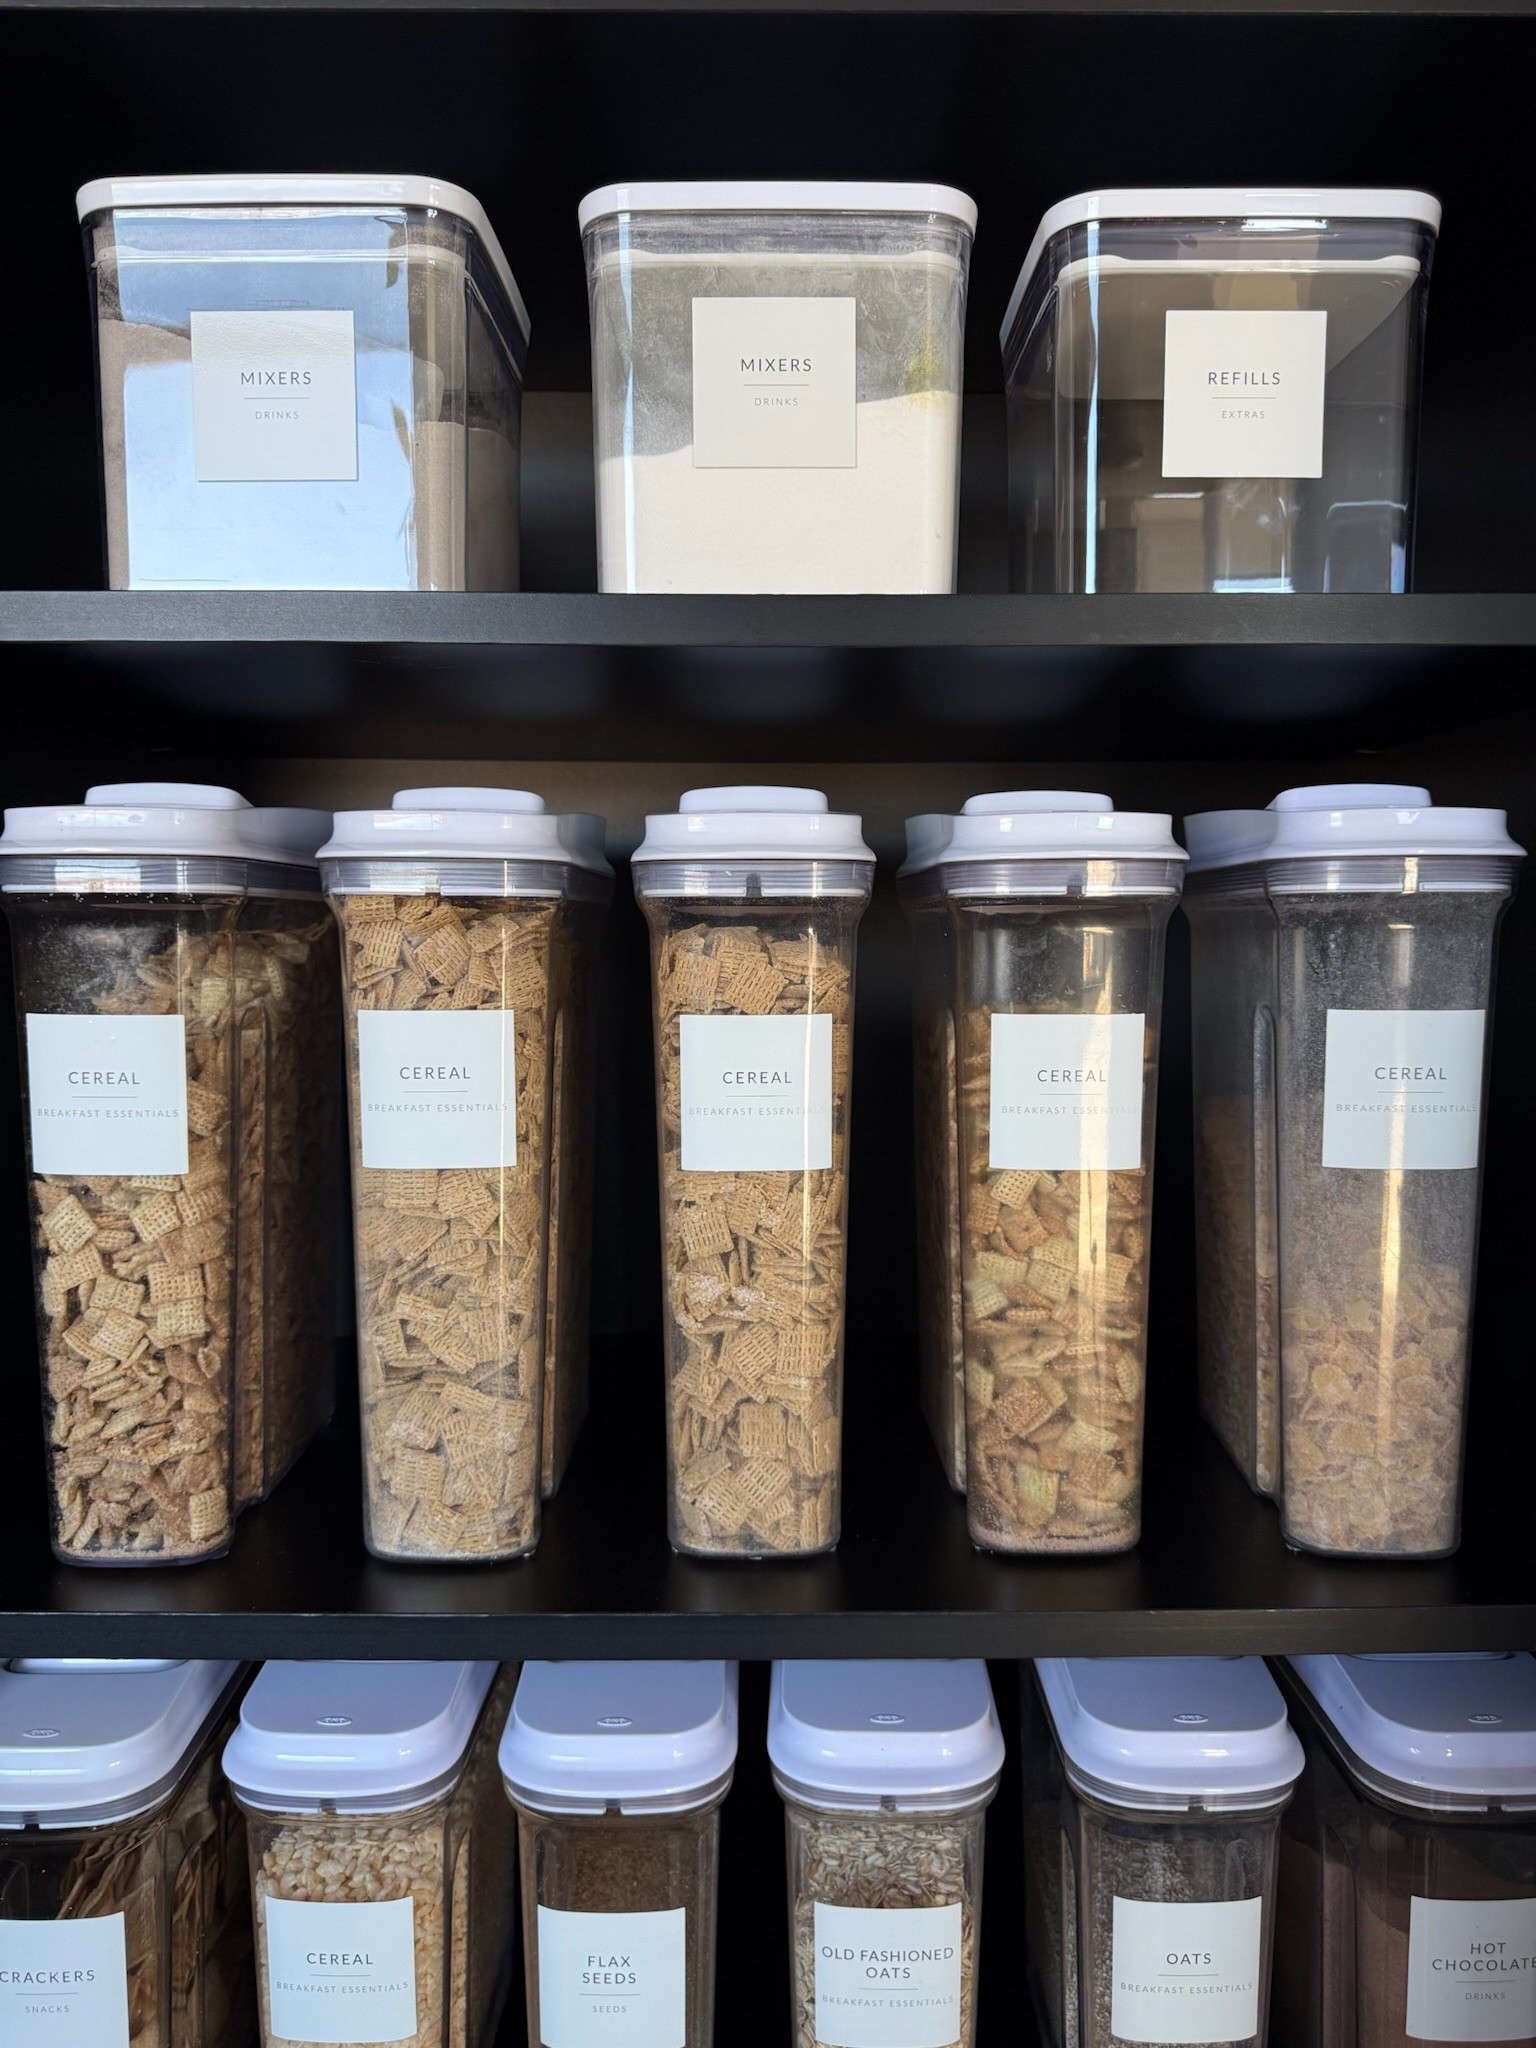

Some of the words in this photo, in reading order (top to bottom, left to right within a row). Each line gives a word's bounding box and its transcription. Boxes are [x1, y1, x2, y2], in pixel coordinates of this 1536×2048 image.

[741, 359, 812, 372] MIXERS
[241, 372, 311, 385] MIXERS
[1209, 372, 1280, 385] REFILLS
[755, 398, 799, 406] DRINKS
[255, 411, 300, 420] DRINKS
[1222, 411, 1266, 419] EXTRAS
[68, 1072, 140, 1084] CEREAL
[400, 1067, 471, 1080] CEREAL
[723, 1072, 791, 1084] CEREAL
[1037, 1070, 1106, 1082] CEREAL
[1375, 1067, 1447, 1080] CEREAL
[37, 1109, 99, 1117] BREAKFAST
[106, 1109, 179, 1118] ESSENTIALS
[368, 1104, 431, 1112] BREAKFAST
[437, 1104, 508, 1112] ESSENTIALS
[689, 1108, 751, 1116] BREAKFAST
[1002, 1105, 1066, 1115] BREAKFAST
[1336, 1104, 1406, 1112] BREAKFAST
[1411, 1103, 1477, 1113] ESSENTIALS
[822, 1946, 855, 1961] OLD
[860, 1947, 954, 1962] FASHIONED
[1471, 1942, 1506, 1955] HOT
[307, 1952, 373, 1965] CEREAL
[588, 1956, 631, 1967] FLAX
[1167, 1953, 1212, 1965] OATS
[0, 1970, 95, 1983] CRACKERS
[582, 1973, 636, 1984] SEEDS
[865, 1967, 911, 1979] OATS
[277, 1981, 336, 1993] BREAKFAST
[341, 1981, 408, 1994] ESSENTIALS
[1120, 1982, 1184, 1994] BREAKFAST
[1190, 1982, 1253, 1994] ESSENTIALS
[822, 1996, 883, 2007] BREAKFAST
[889, 1996, 954, 2007] ESSENTIALS
[1465, 1992, 1506, 2000] DRINKS
[25, 2005, 69, 2013] SNACKS
[592, 2005, 627, 2013] SEEDS
